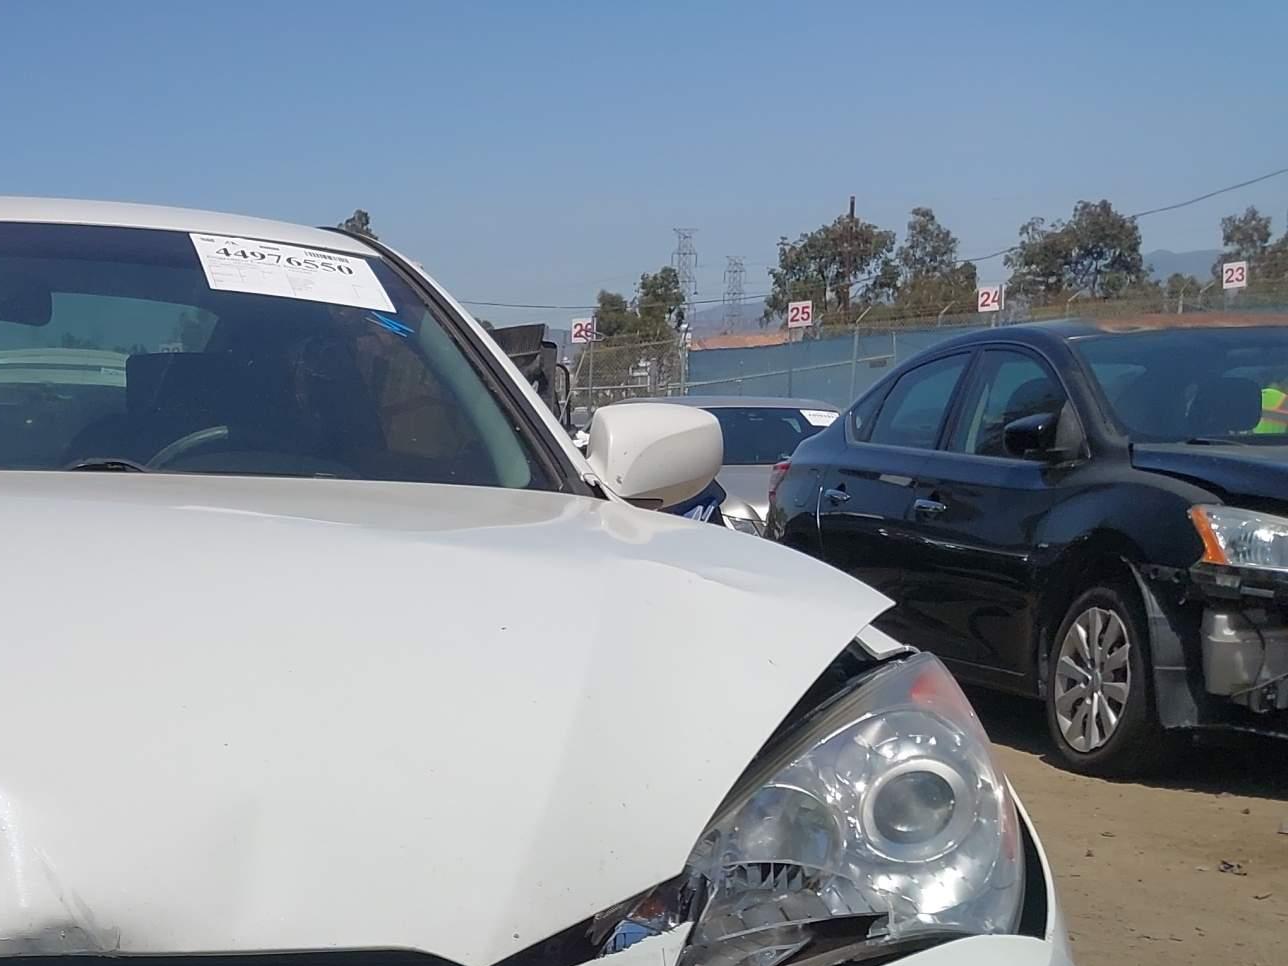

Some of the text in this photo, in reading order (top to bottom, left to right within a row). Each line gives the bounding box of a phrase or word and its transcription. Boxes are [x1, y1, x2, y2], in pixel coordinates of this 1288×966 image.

[215, 247, 354, 275] 44976550
[1224, 266, 1245, 284] 23
[979, 291, 1001, 307] 24
[789, 306, 811, 322] 25
